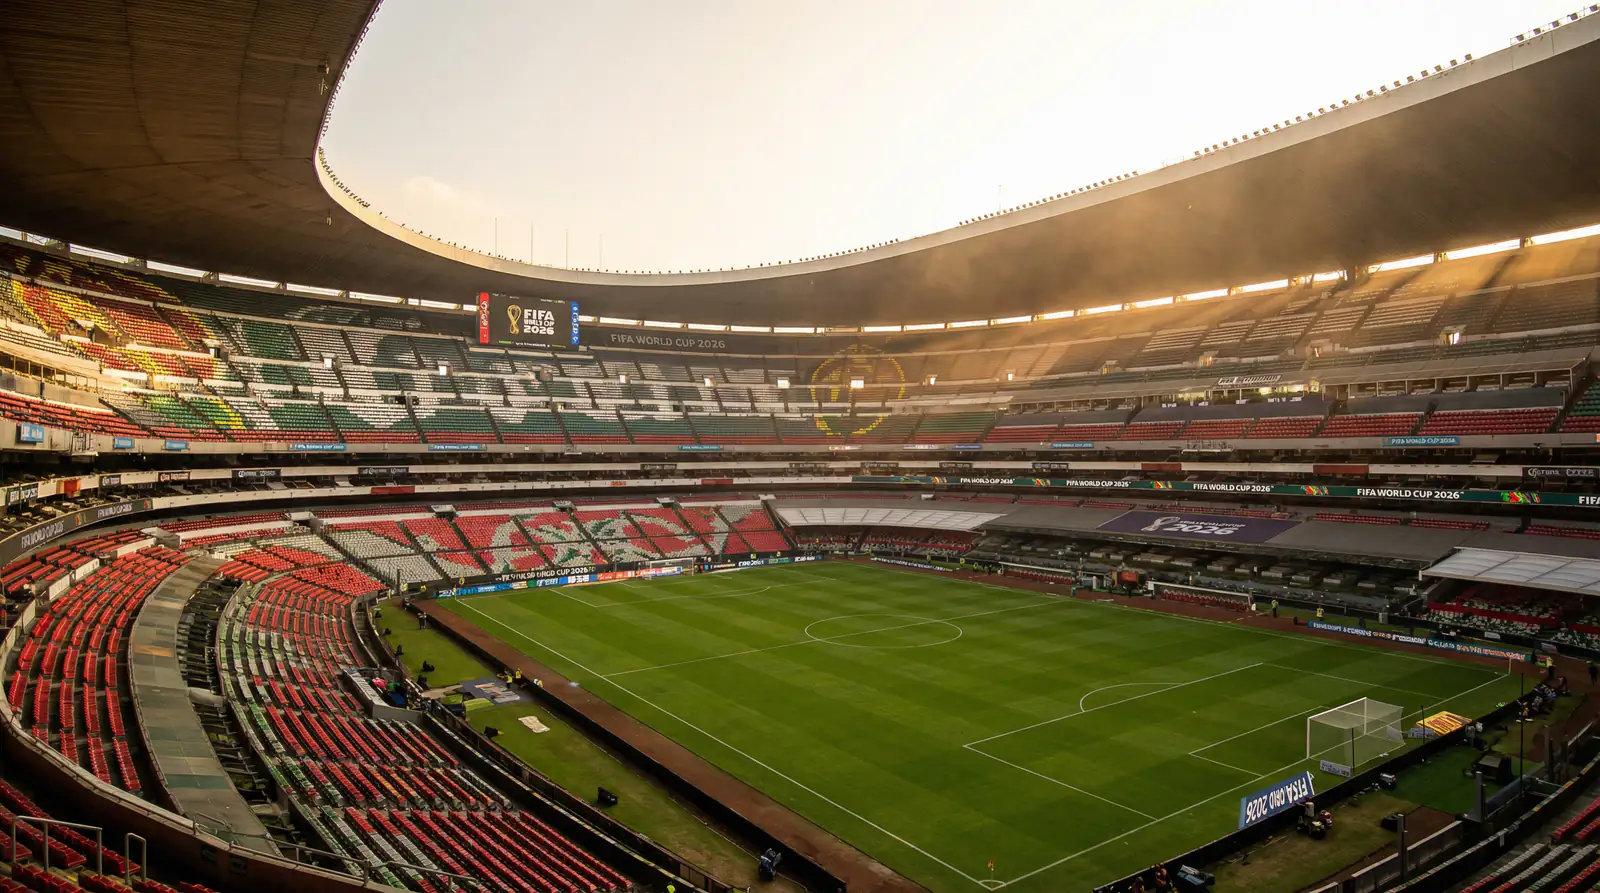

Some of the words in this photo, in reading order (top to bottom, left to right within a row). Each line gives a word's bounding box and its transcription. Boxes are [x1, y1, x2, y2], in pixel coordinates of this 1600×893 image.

[523, 308, 555, 321] FIFA
[523, 325, 555, 335] 2026
[611, 334, 634, 344] FIFA
[636, 335, 672, 346] WORLD
[675, 338, 695, 348] CUP
[697, 339, 726, 349] 2026
[1208, 483, 1235, 491] WORLD
[1235, 484, 1250, 492] CUP
[1357, 488, 1376, 496] FIFA
[1376, 489, 1412, 497] WORLD
[1413, 490, 1433, 498] CUP
[1434, 490, 1460, 499] 2026
[1163, 523, 1239, 535] 2026
[556, 569, 570, 577] CUP
[1245, 794, 1268, 824] 2026
